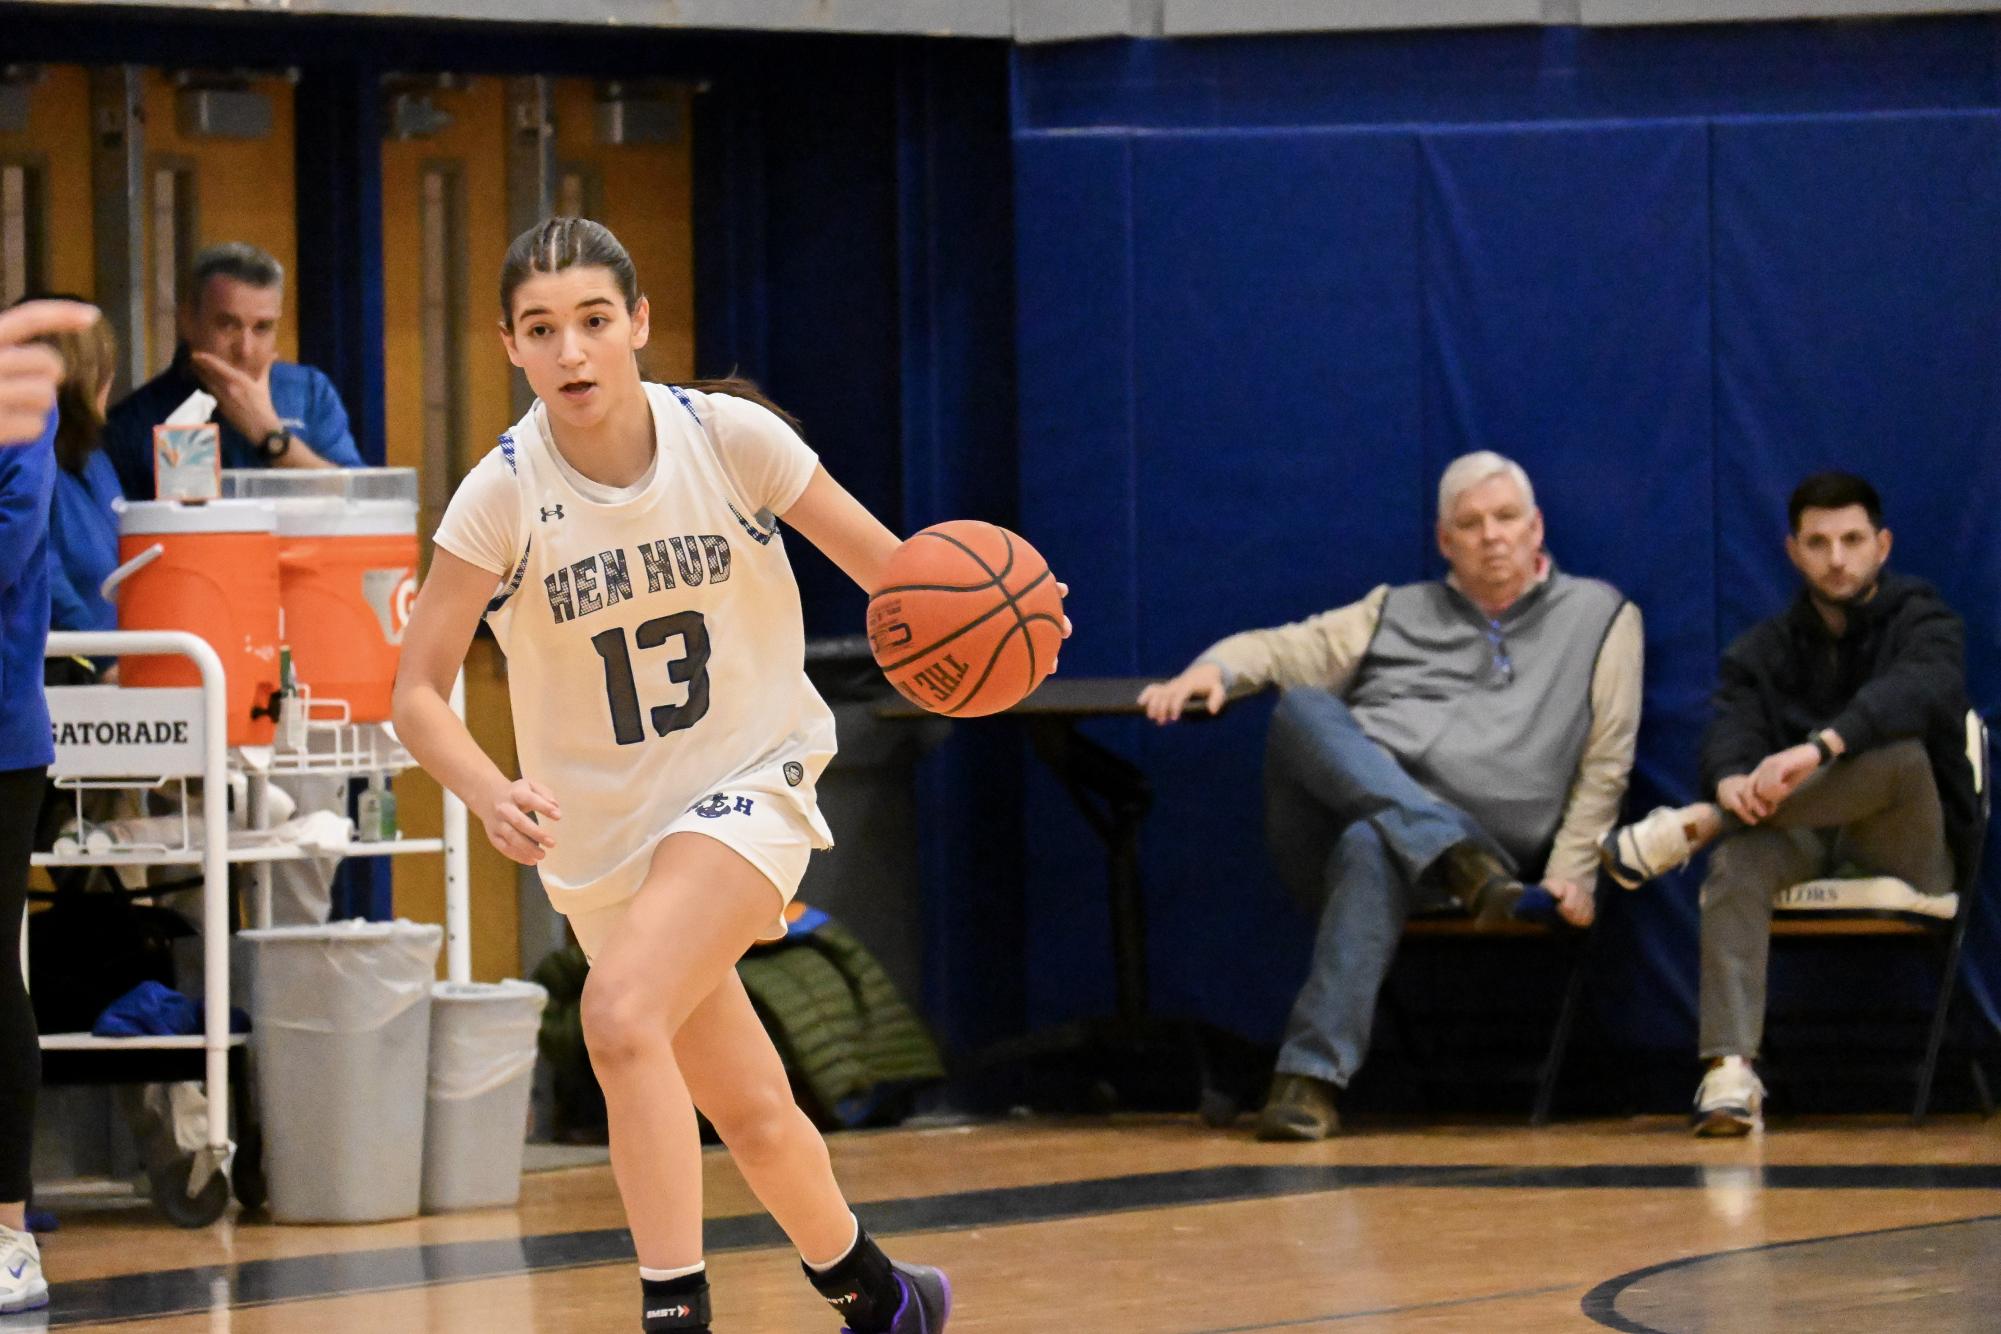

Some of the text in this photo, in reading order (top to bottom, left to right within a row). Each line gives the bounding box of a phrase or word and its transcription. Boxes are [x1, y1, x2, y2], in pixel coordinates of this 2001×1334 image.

[543, 534, 732, 625] HEN HUD
[590, 610, 712, 746] 13
[913, 653, 970, 702] THE
